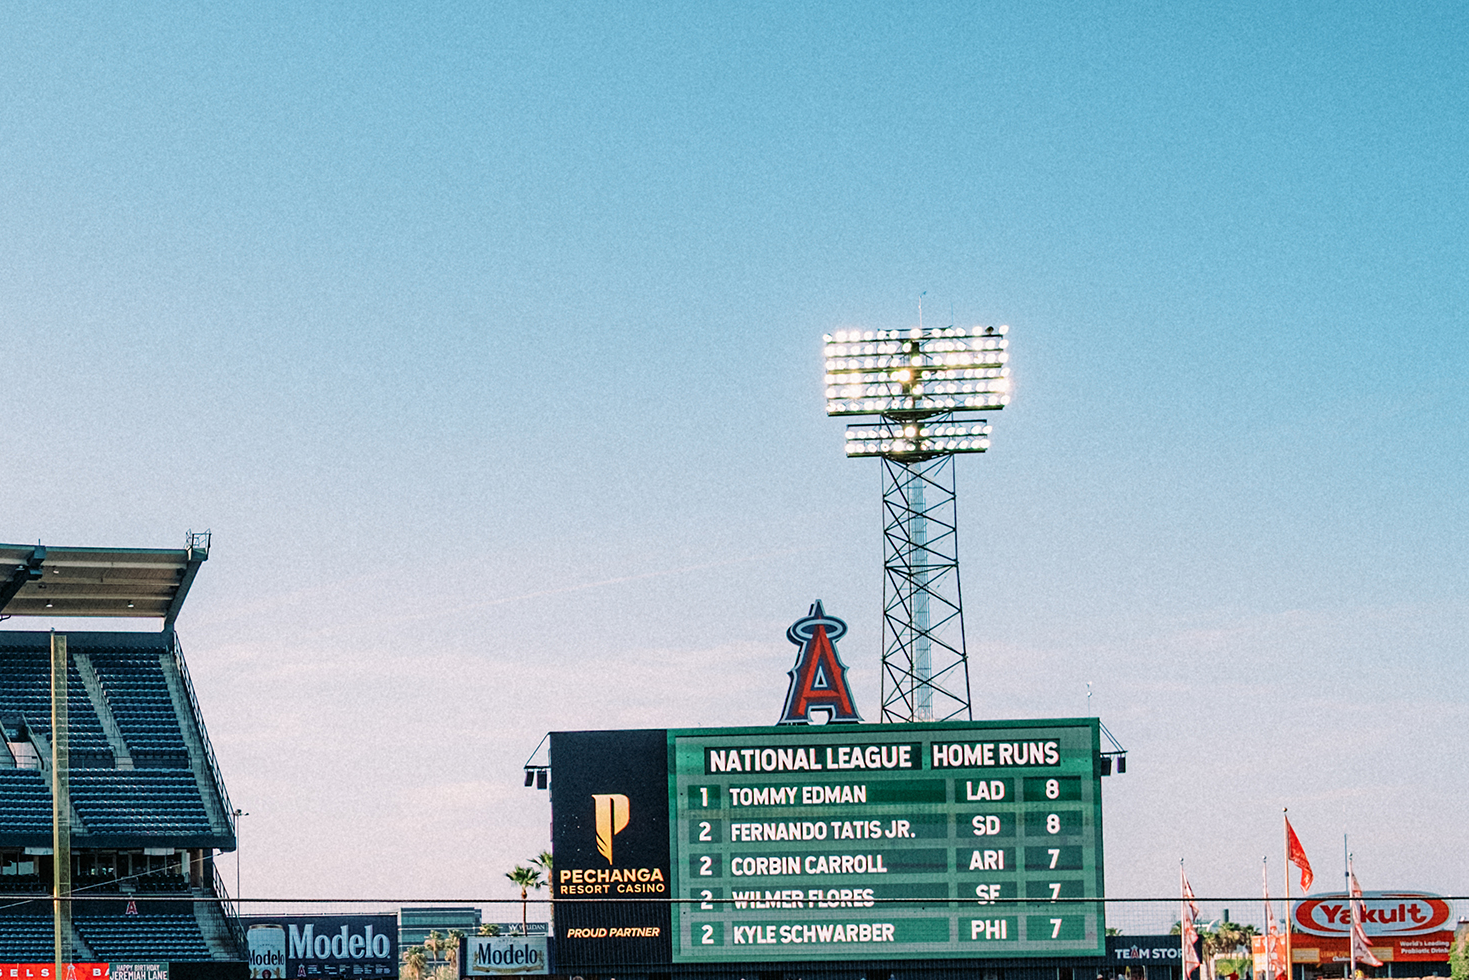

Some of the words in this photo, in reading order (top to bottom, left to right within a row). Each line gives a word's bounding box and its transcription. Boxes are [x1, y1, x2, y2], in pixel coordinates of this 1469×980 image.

[709, 748, 823, 773] NATIONAL
[828, 746, 913, 769] LEAGUE
[932, 744, 995, 768] HOME
[997, 742, 1060, 766] RUNS
[699, 788, 709, 807] 1
[730, 786, 798, 806] TOMMY
[801, 785, 867, 804] EDMAN
[965, 781, 1006, 801] LAD
[1045, 780, 1060, 799] 8
[698, 821, 713, 842] 2
[731, 822, 828, 842] FERNANDO
[831, 820, 881, 840] TATIS
[884, 819, 916, 839] JR.
[972, 815, 1001, 836] SD
[1046, 814, 1060, 834] 8
[698, 855, 713, 876] 2
[731, 856, 800, 876] CORBIN
[803, 854, 887, 874] CARROLL
[968, 850, 1004, 871] ARI
[1047, 849, 1060, 869] 7
[560, 868, 664, 884] PECHANGA
[560, 884, 610, 894] RESORT
[616, 883, 665, 894] CASINO
[699, 890, 714, 910] 2
[733, 890, 804, 910] WILMER
[806, 889, 875, 908] FLORES
[975, 884, 1000, 905] SF
[1048, 883, 1062, 903] 7
[1319, 903, 1428, 924] Yakult
[567, 928, 608, 939] PROUD
[609, 927, 661, 938] PARTNER
[700, 924, 715, 944] 2
[733, 924, 777, 944] KYLE
[779, 923, 895, 943] SCHWARBER
[970, 919, 1007, 940] PHI
[1049, 918, 1062, 938] 7
[478, 943, 538, 965] Modelo
[1115, 946, 1150, 959] TEAM
[1152, 948, 1183, 959] STO
[109, 971, 146, 980] JEREMIAH
[148, 970, 168, 980] LANE
